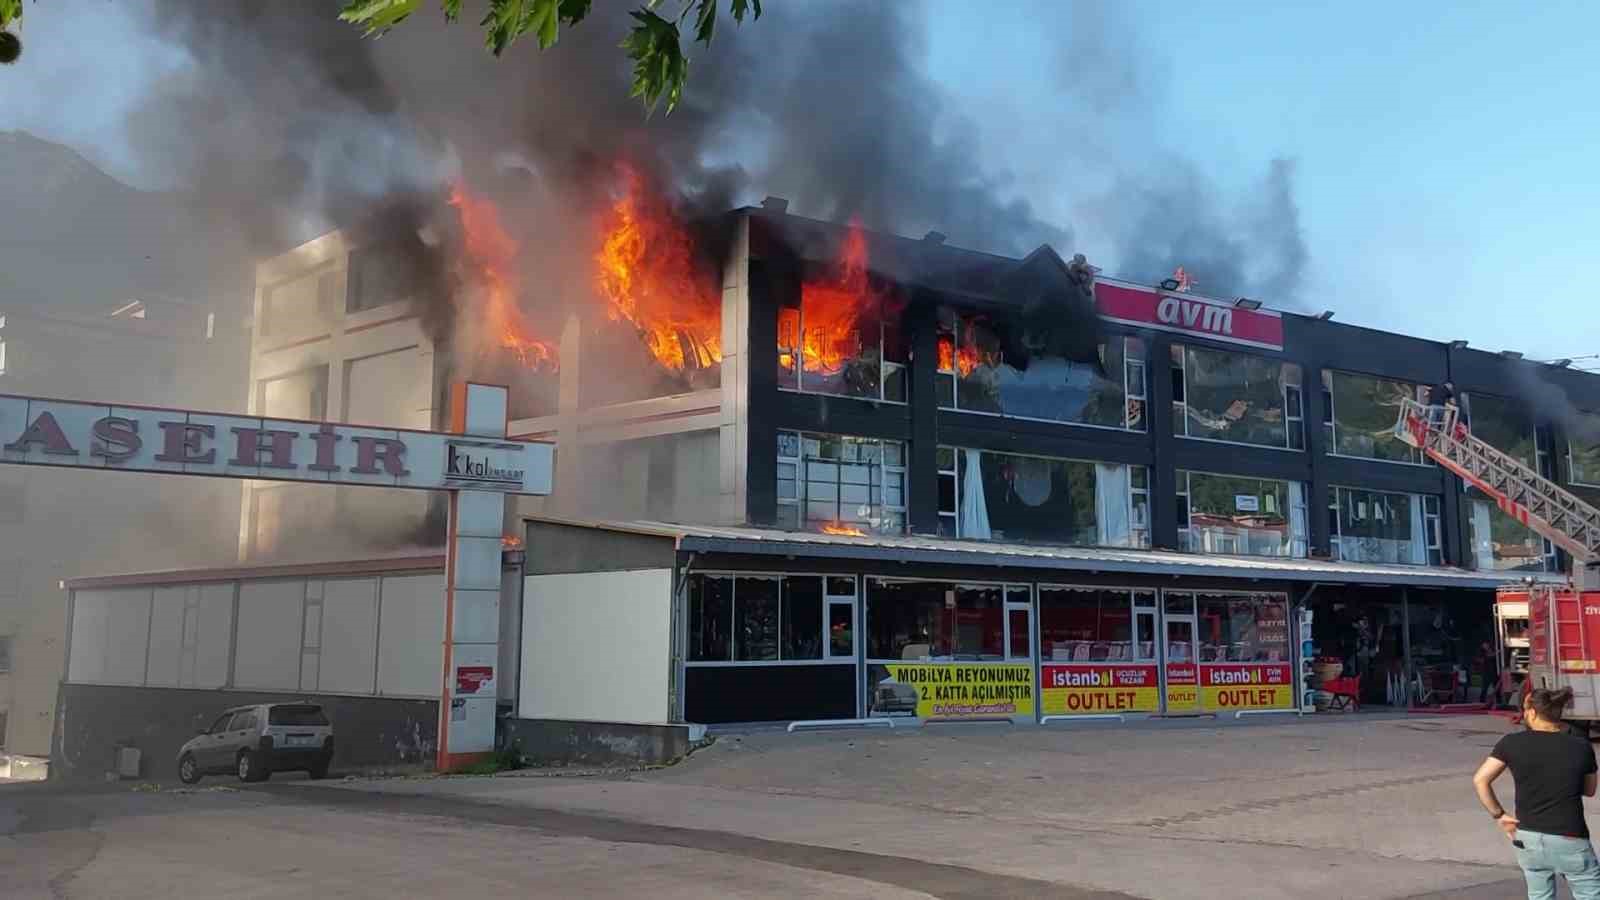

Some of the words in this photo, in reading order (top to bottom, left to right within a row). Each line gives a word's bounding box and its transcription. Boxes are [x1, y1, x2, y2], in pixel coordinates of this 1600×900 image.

[1157, 298, 1233, 335] avm
[956, 668, 1031, 682] REYONUMUZ
[921, 686, 932, 700] 2.
[936, 685, 968, 700] KATTA
[1168, 692, 1196, 702] OUTLET
[1218, 690, 1277, 706] OUTLET
[1067, 692, 1137, 710] OUTLET
